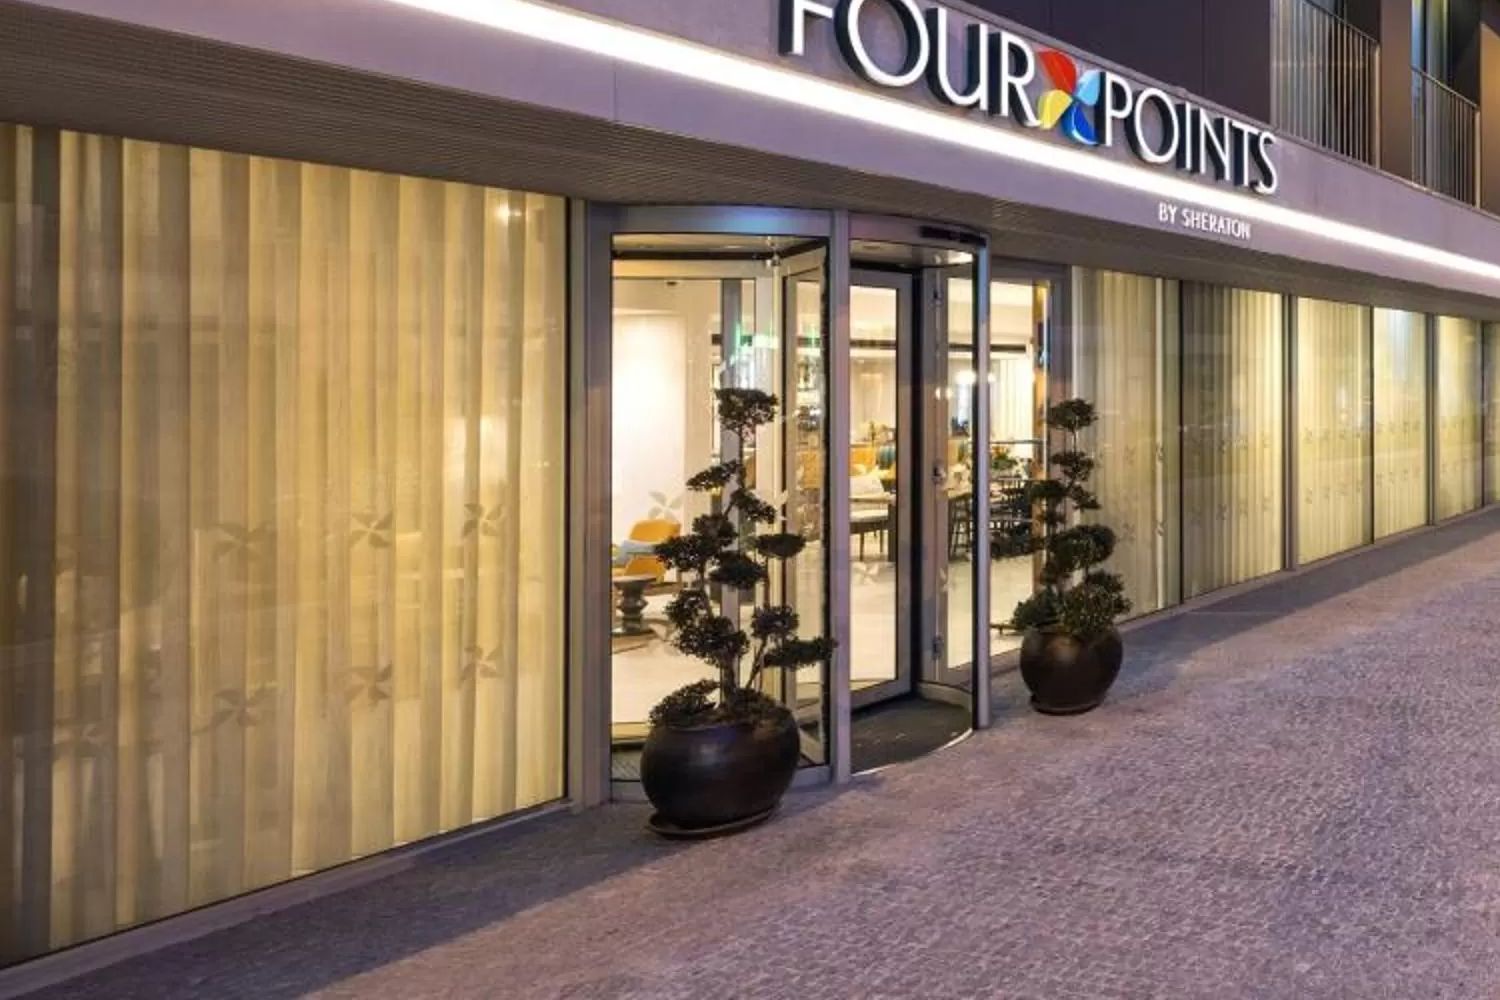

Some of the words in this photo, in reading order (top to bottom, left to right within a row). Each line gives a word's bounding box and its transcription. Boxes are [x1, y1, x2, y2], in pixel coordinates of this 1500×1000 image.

[1103, 71, 1277, 195] POINTS
[1158, 201, 1178, 225] BY
[1182, 207, 1251, 240] SHERATON
